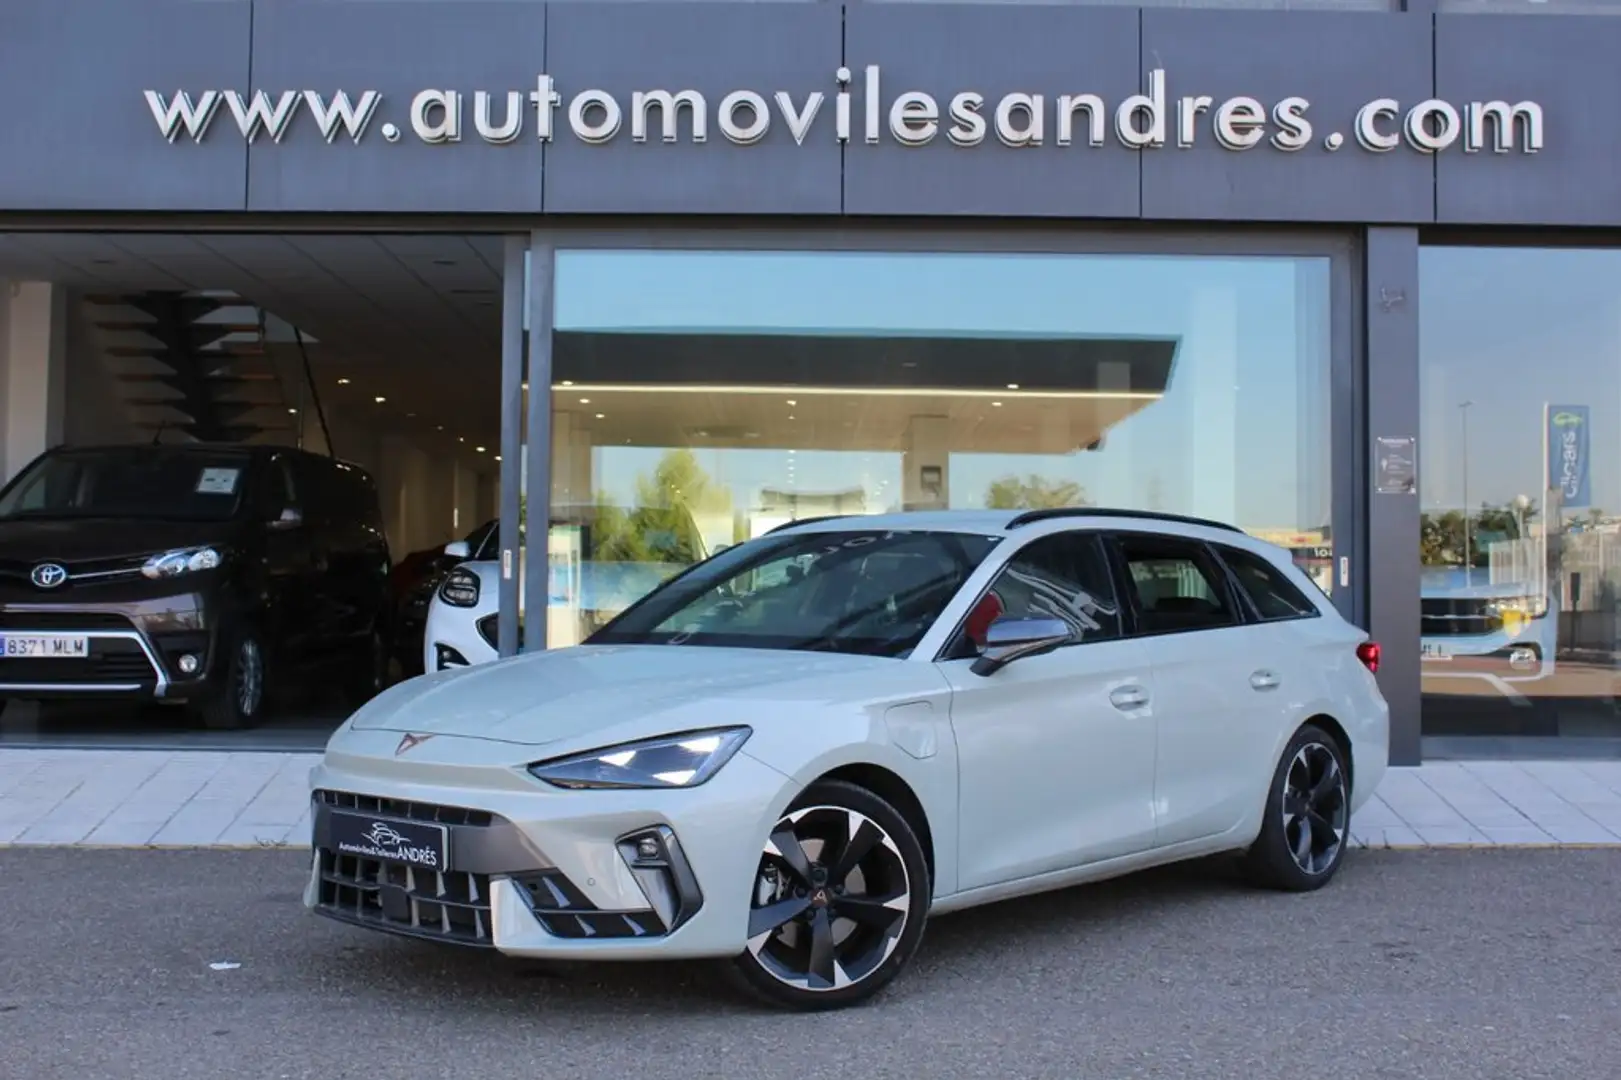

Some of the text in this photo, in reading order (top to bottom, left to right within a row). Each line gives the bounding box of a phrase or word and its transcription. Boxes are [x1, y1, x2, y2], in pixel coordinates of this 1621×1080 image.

[143, 65, 1544, 154] www.automovilesandres.com
[7, 639, 46, 654] 8371
[53, 639, 84, 654] MLM
[397, 844, 437, 866] ANDRÉS
